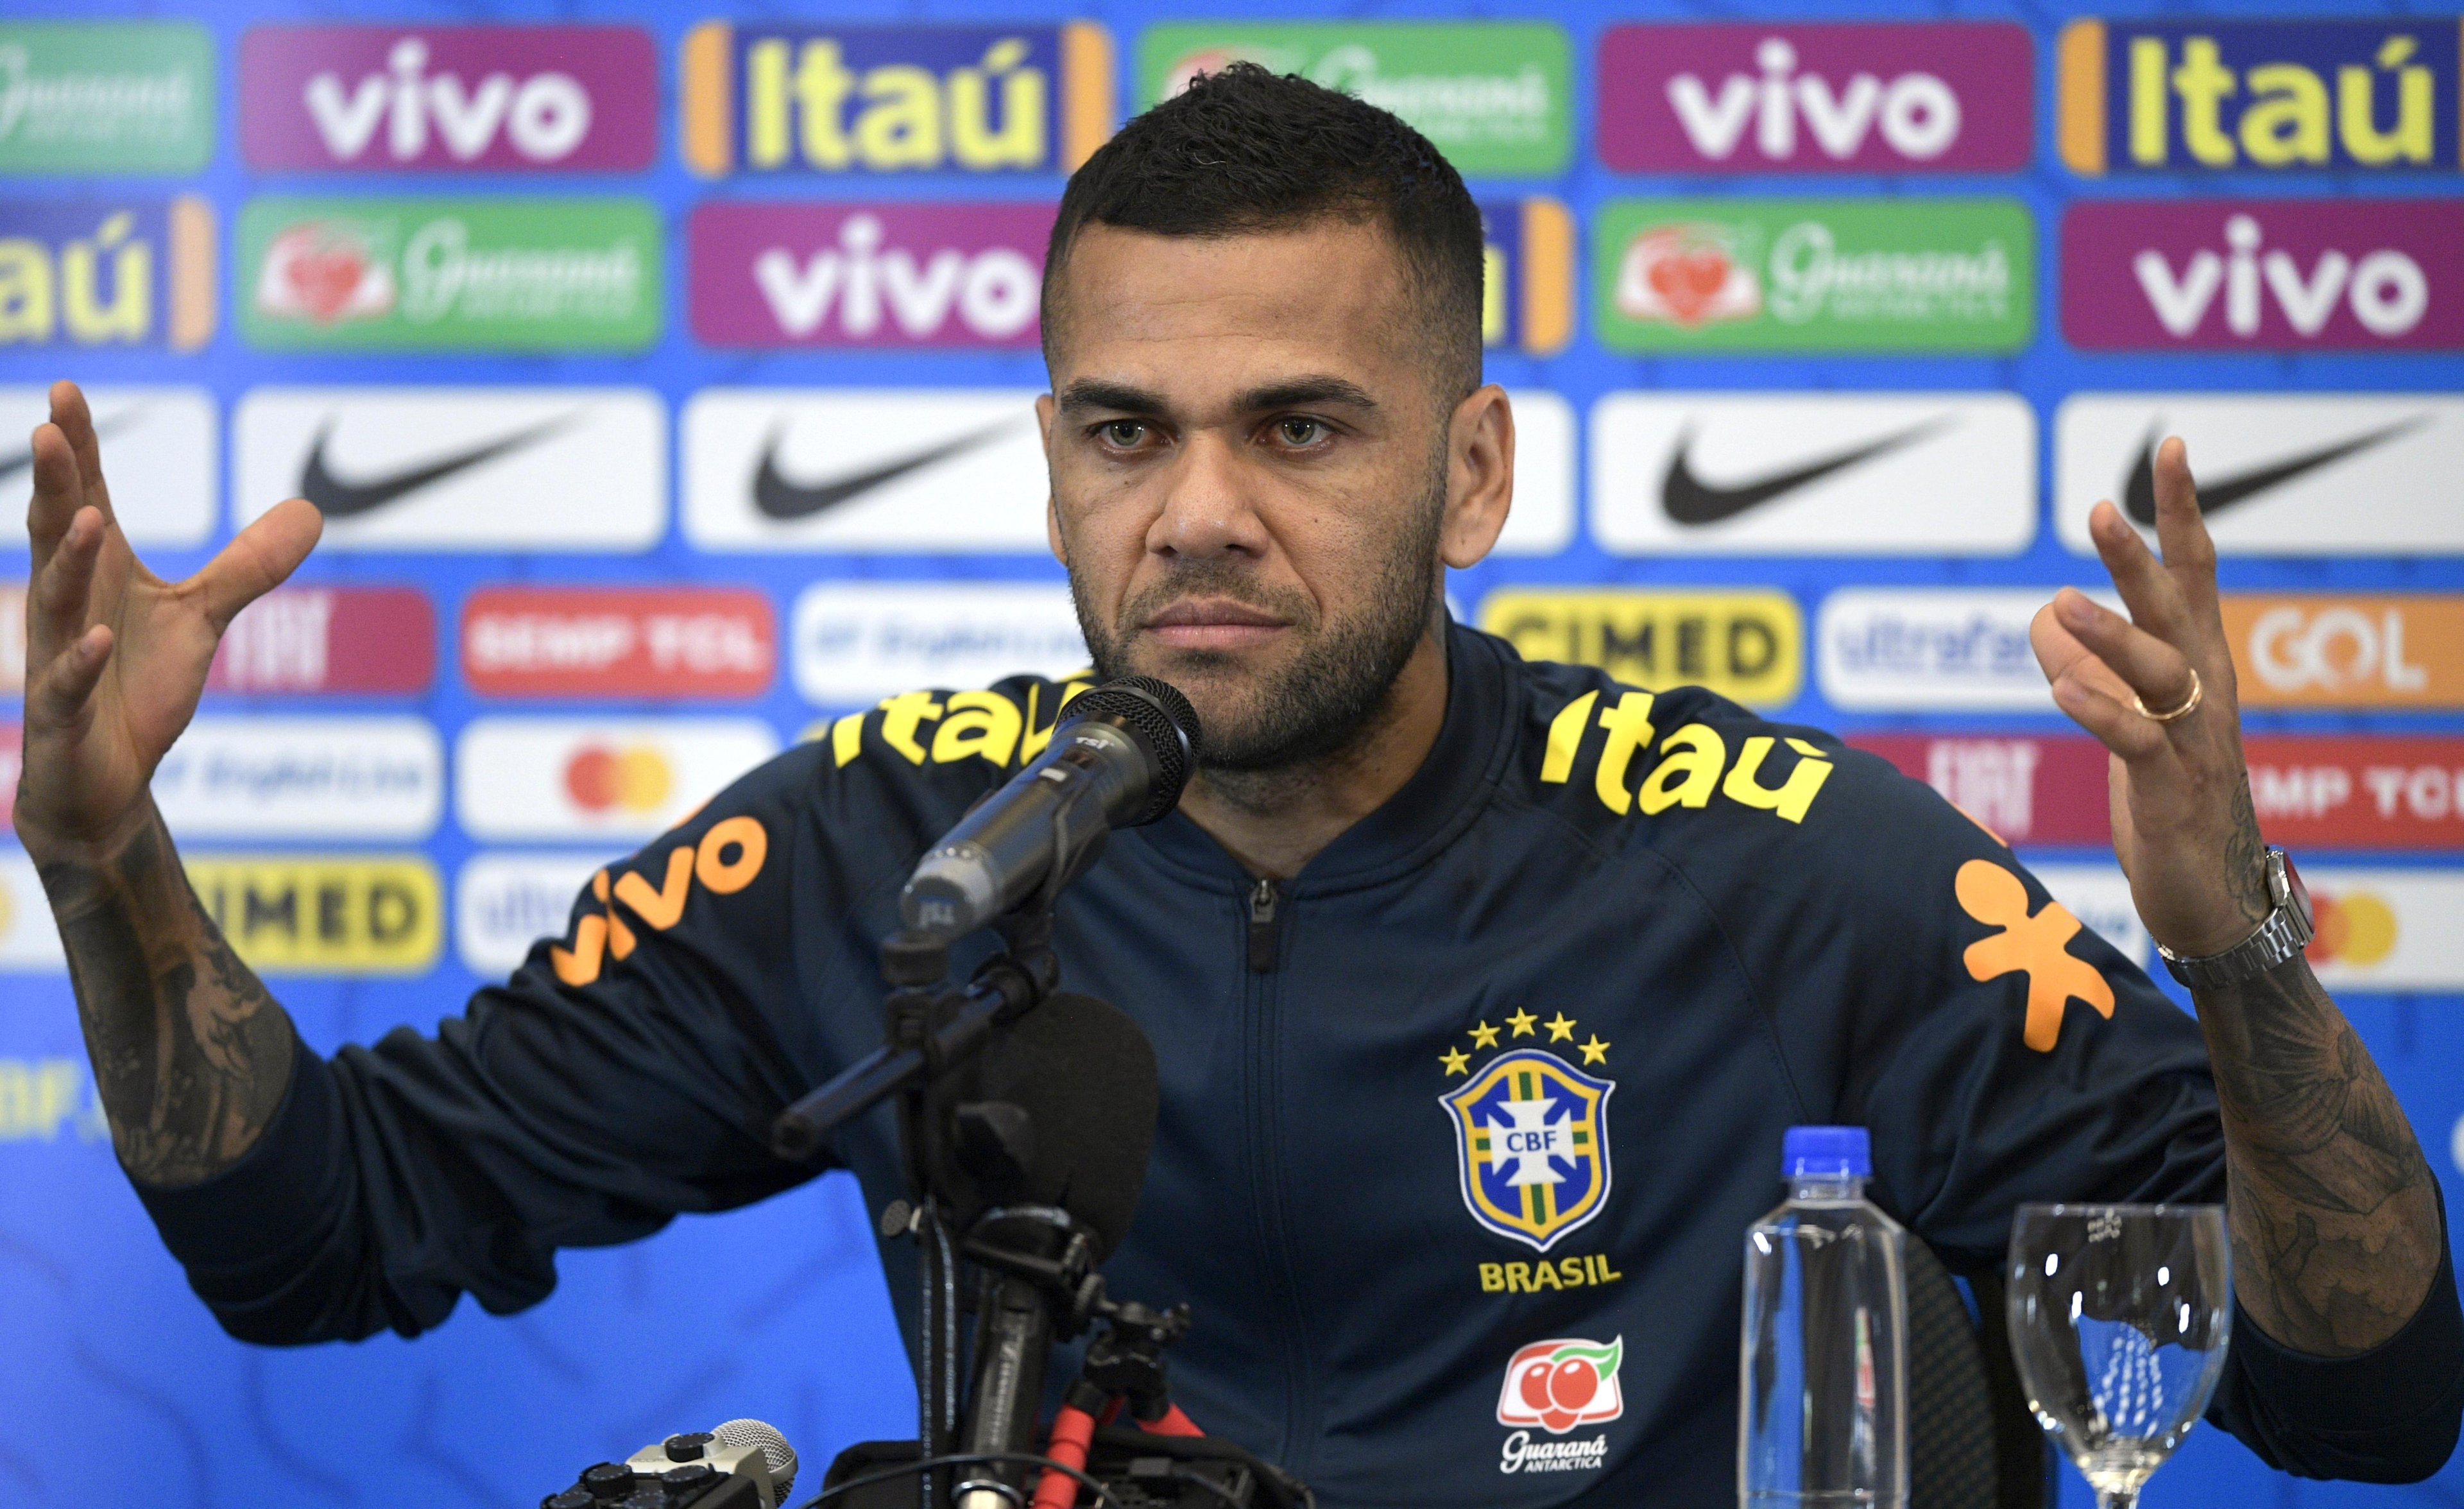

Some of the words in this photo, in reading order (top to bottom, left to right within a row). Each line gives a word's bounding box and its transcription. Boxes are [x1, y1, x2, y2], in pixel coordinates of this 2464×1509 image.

[305, 38, 590, 160] vivo
[748, 38, 1047, 170] Itaú
[1666, 37, 1961, 160] vivo
[2130, 36, 2435, 166] Itaú
[0, 213, 150, 345] aú
[754, 214, 1041, 337] vivo
[2133, 213, 2430, 338] vivo
[2248, 606, 2427, 693] GOL
[2362, 765, 2464, 819] TC
[212, 880, 420, 948] IMED
[549, 815, 768, 987] vivo
[1505, 1130, 1557, 1153] CBF
[1478, 1253, 1622, 1294] BRASIL
[1500, 1430, 1609, 1474] Guaraná
[1523, 1456, 1602, 1473] ANTARCTICA
